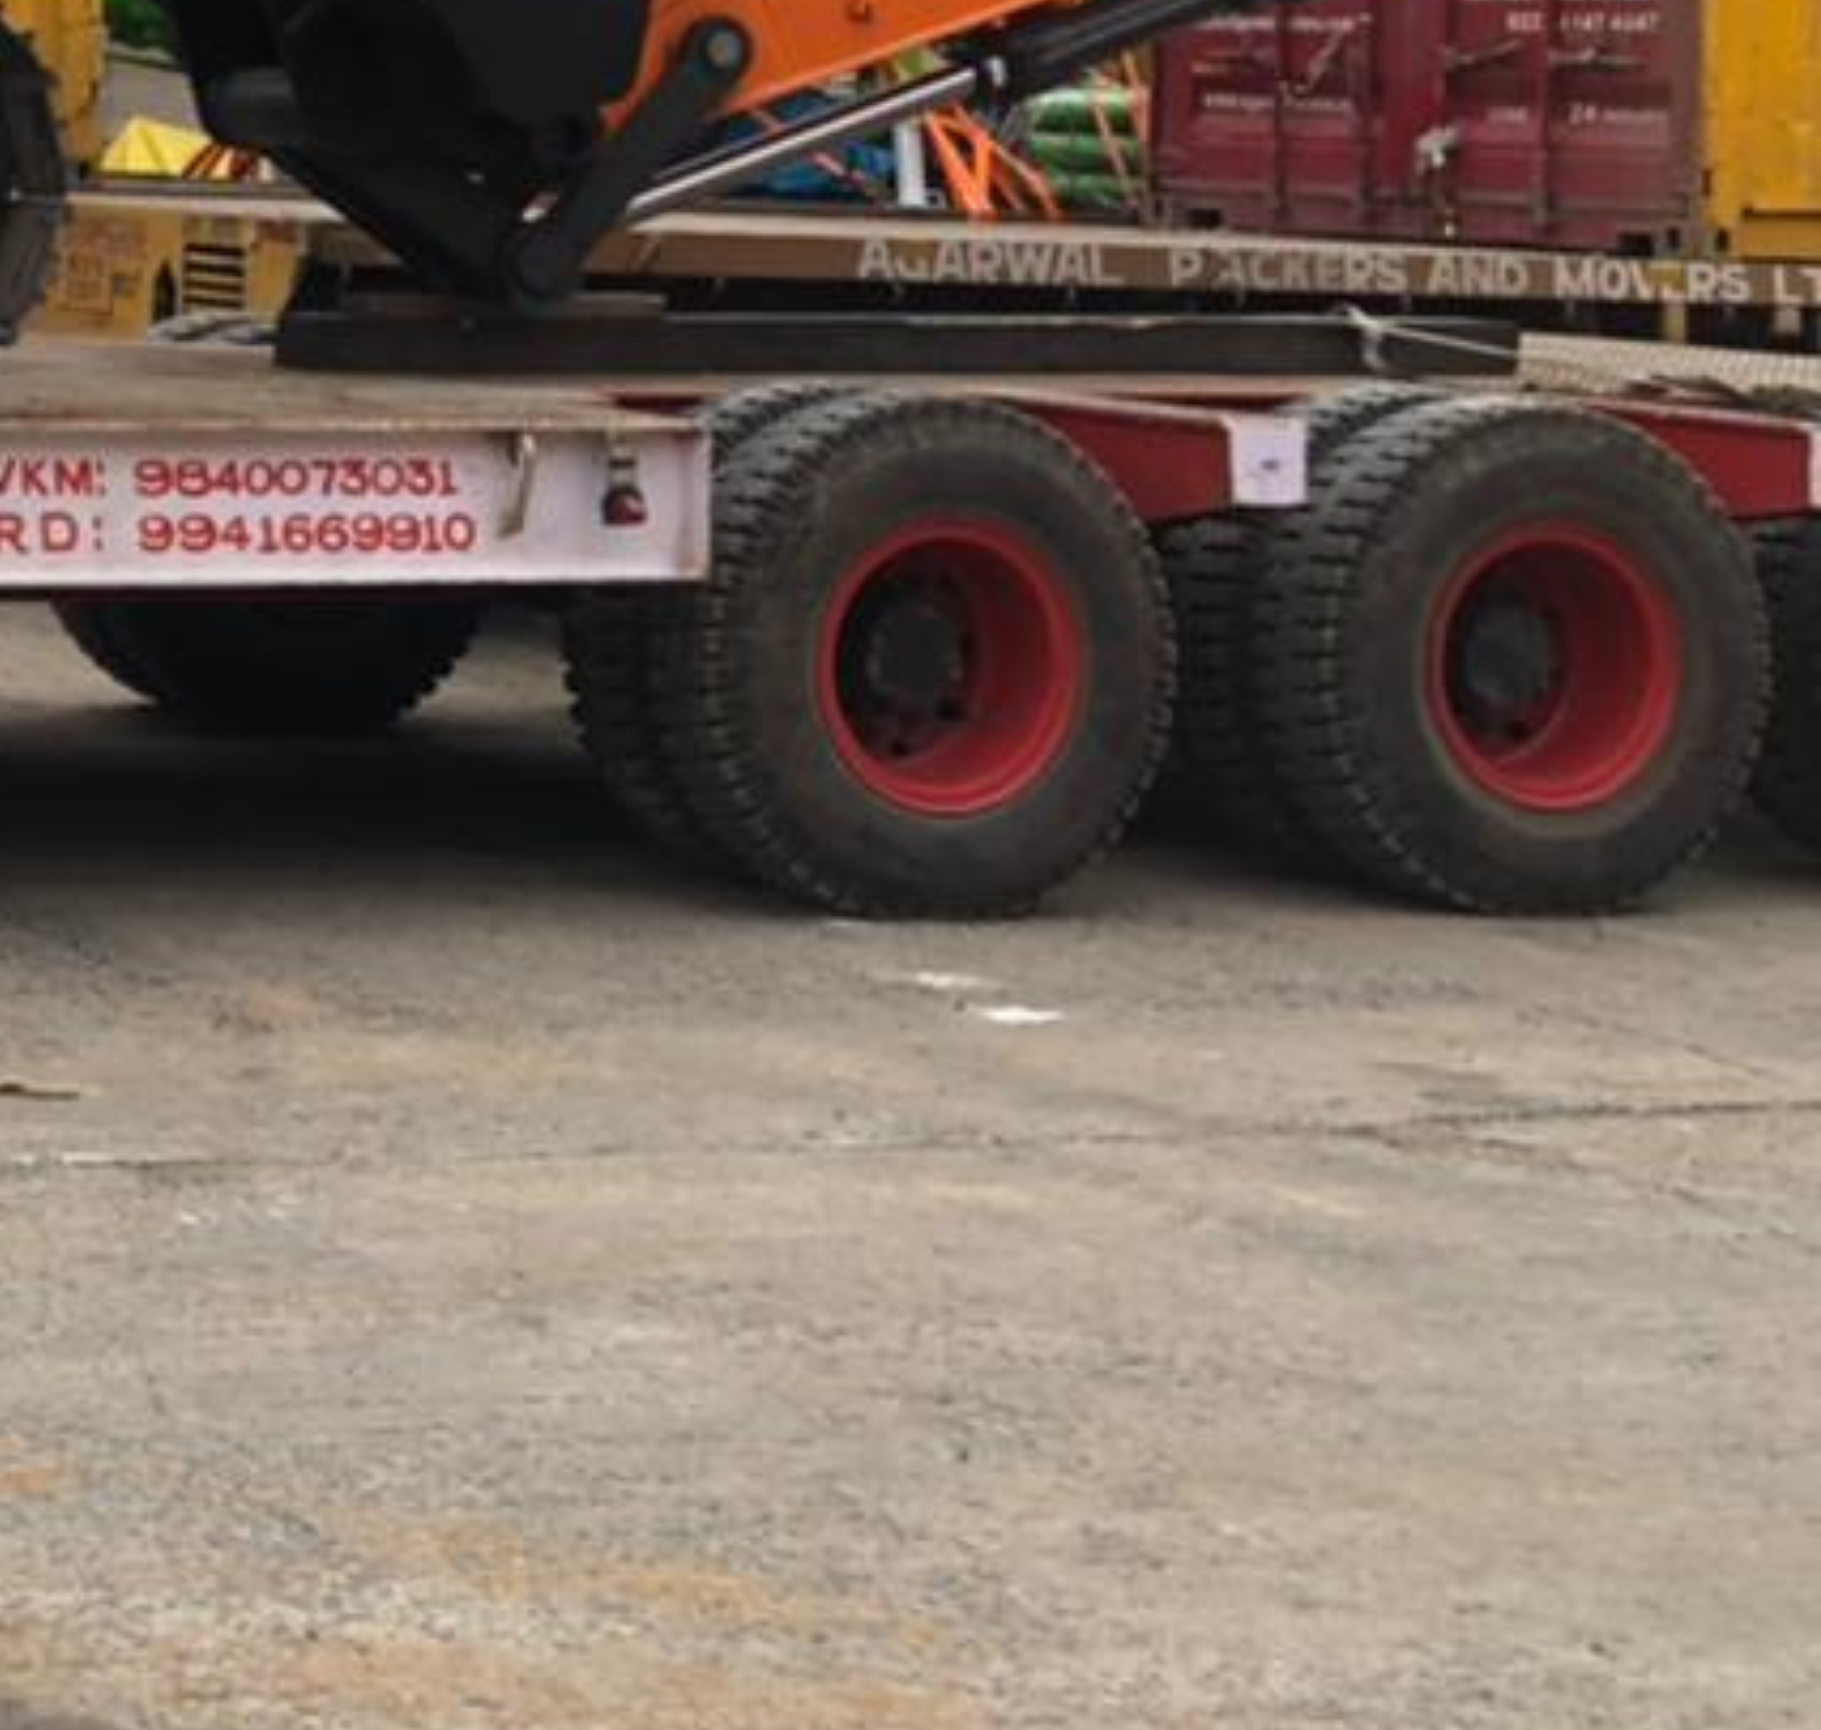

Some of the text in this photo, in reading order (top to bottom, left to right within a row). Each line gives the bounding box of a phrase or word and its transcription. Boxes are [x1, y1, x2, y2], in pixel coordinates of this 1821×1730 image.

[1428, 252, 1529, 296] AND
[135, 458, 459, 497] 9840073031
[138, 513, 477, 554] 9941669910
